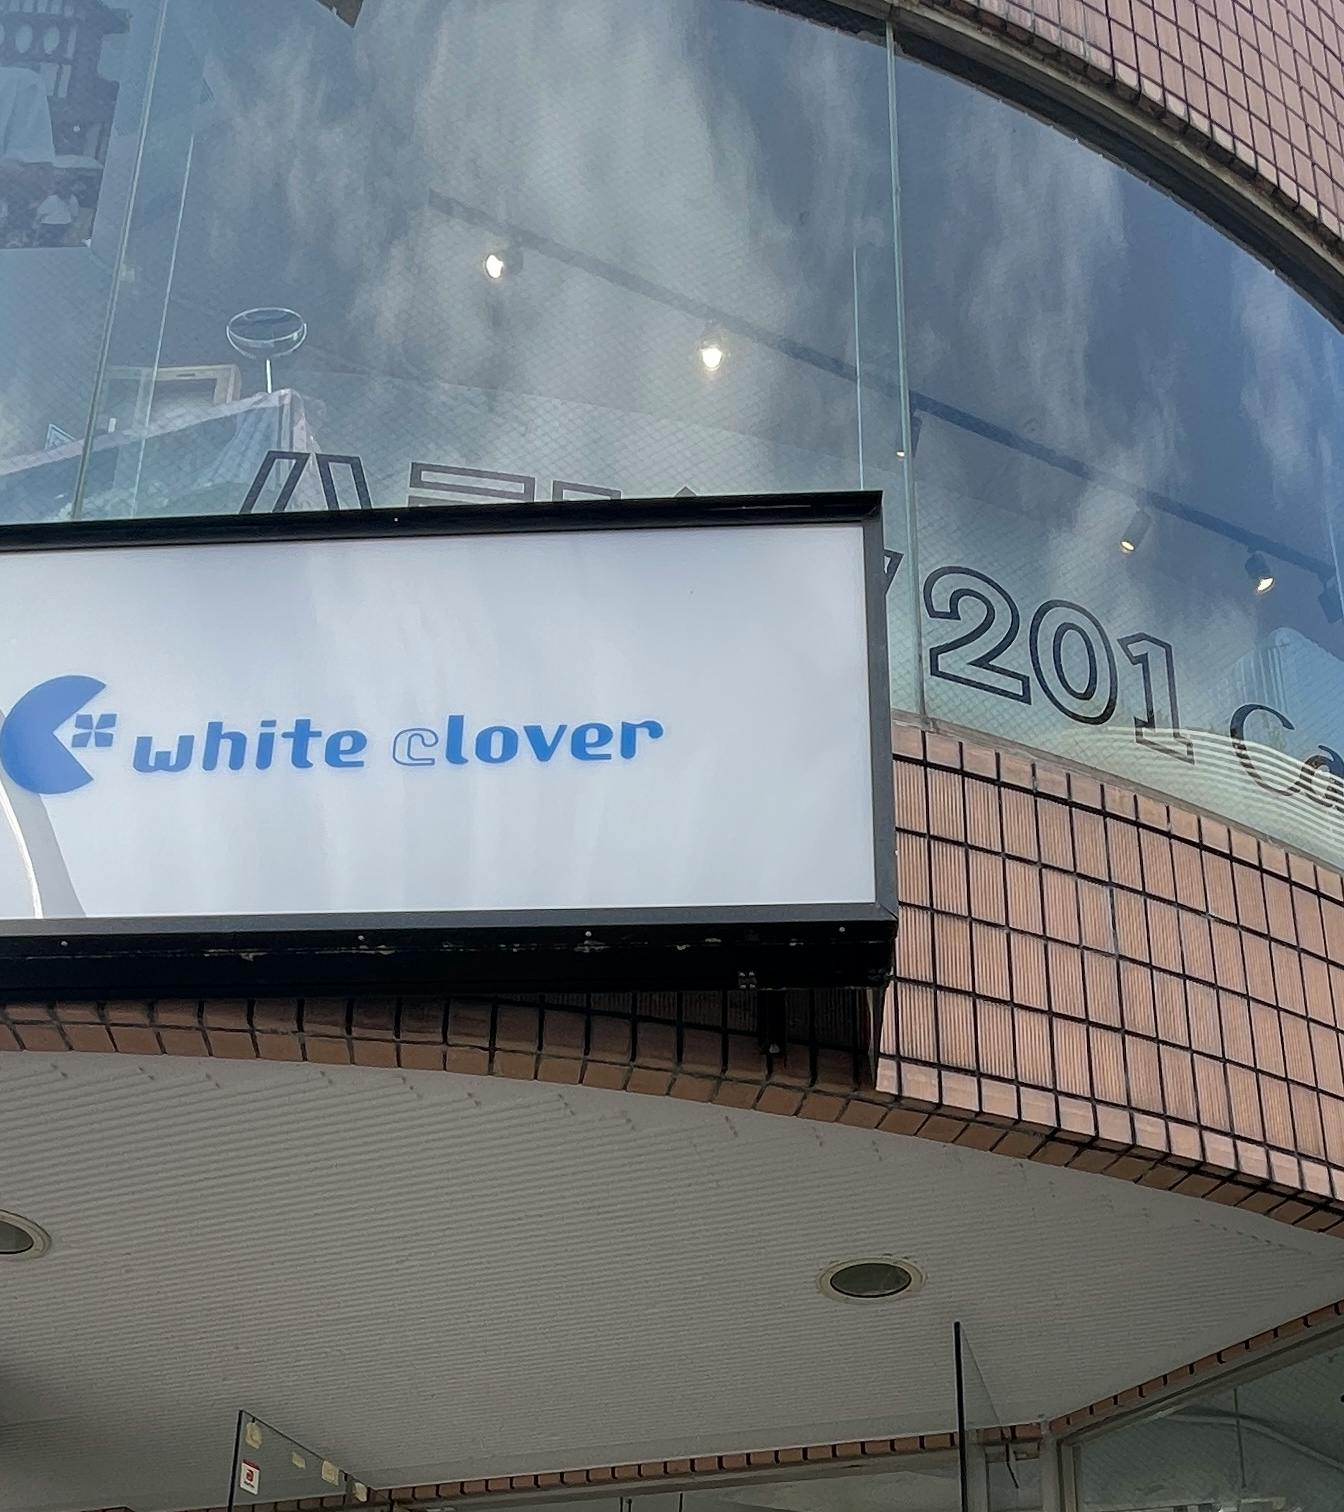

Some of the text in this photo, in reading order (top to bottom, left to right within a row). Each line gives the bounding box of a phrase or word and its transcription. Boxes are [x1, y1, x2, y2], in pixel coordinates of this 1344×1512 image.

[923, 566, 1195, 764] 201
[132, 714, 664, 773] white clover
